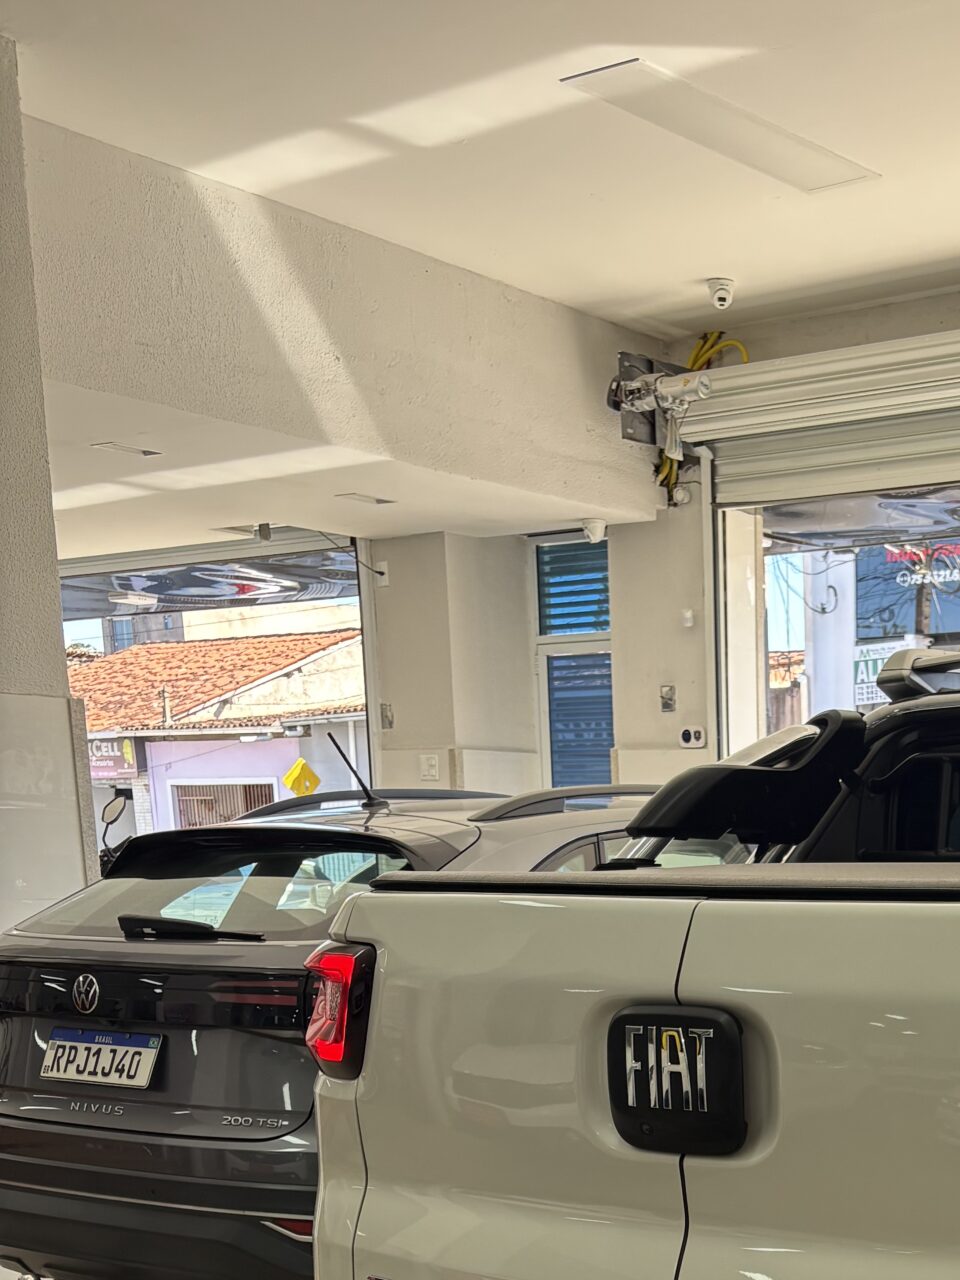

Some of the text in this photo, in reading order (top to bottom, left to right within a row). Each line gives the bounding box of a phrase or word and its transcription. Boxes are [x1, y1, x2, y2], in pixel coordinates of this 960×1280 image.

[50, 1044, 143, 1080] RPJ1J40
[625, 1024, 714, 1113] FIAT
[70, 1101, 125, 1116] NIVUS
[221, 1116, 253, 1126] 200
